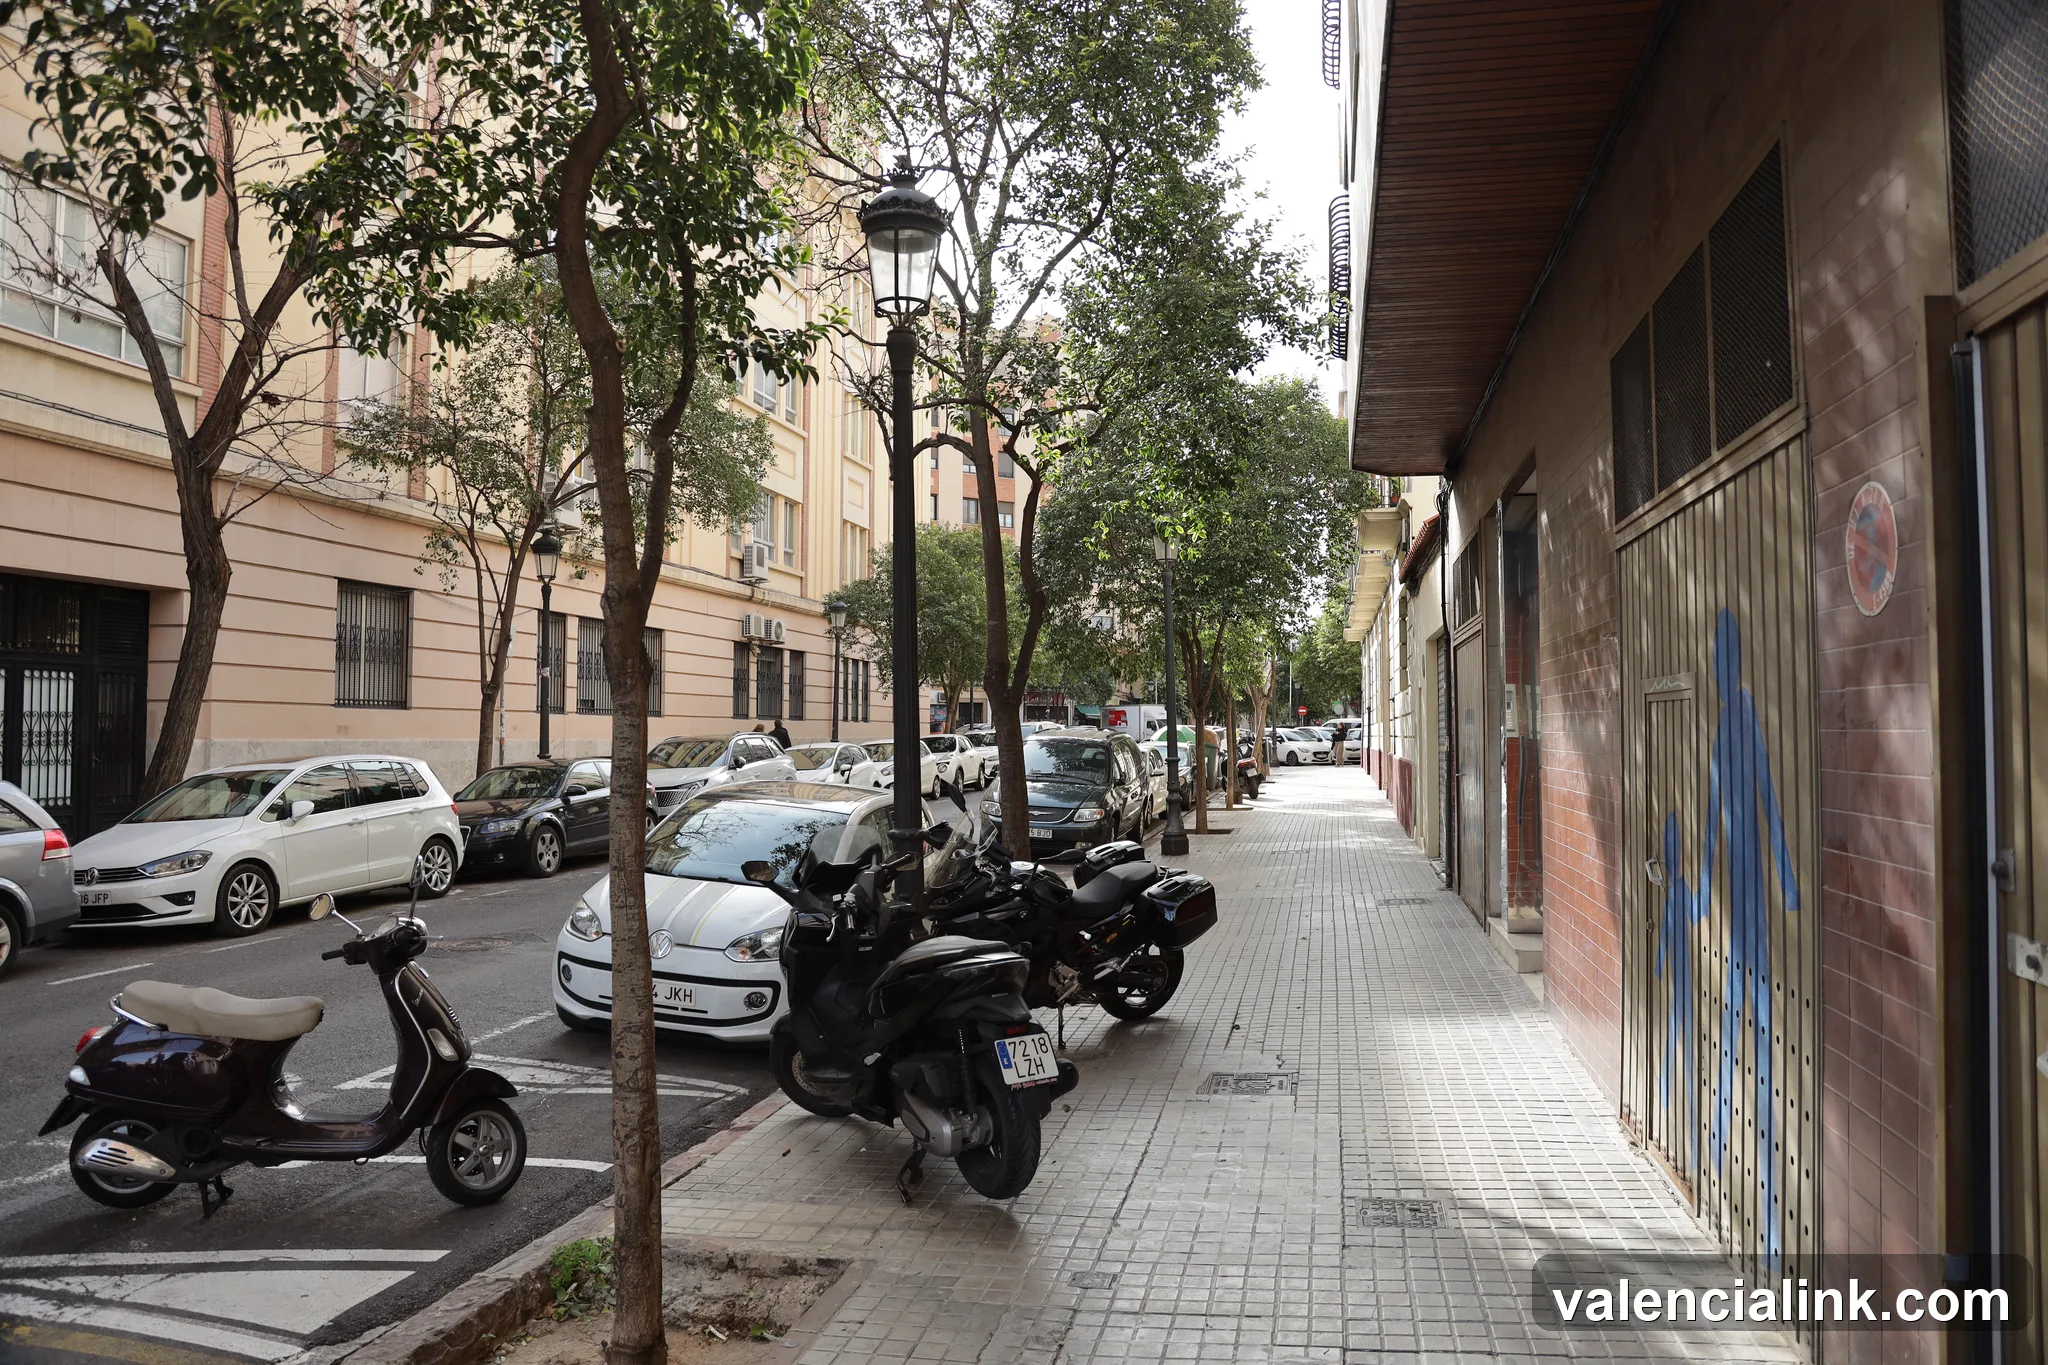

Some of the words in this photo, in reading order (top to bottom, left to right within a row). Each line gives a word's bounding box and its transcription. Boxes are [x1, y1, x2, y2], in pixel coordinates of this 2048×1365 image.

[91, 893, 108, 904] JFP
[664, 986, 692, 1003] JKH
[1008, 1037, 1048, 1059] 7218
[1014, 1057, 1045, 1078] LZH
